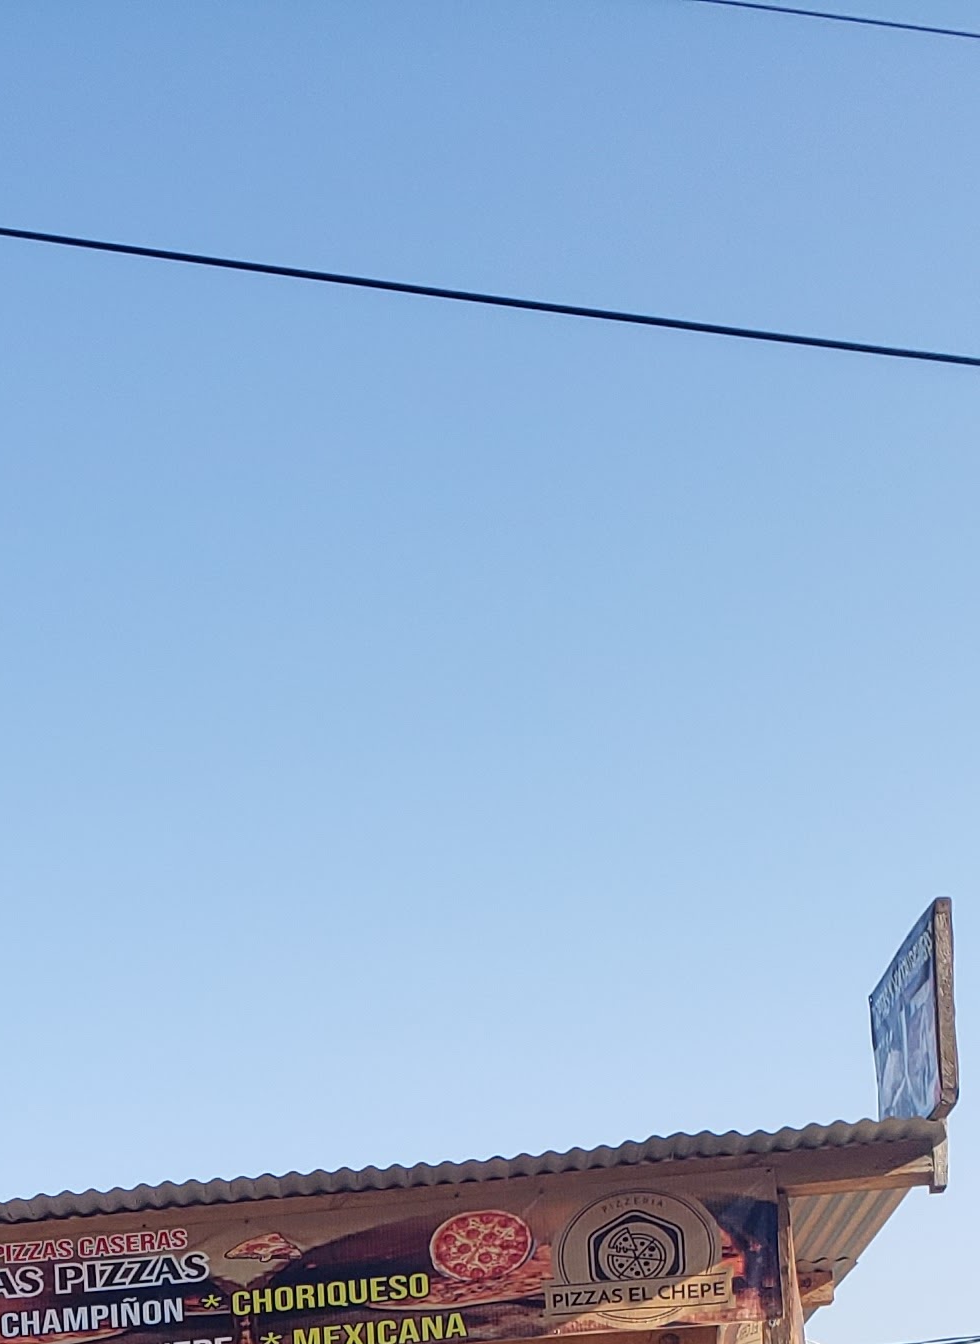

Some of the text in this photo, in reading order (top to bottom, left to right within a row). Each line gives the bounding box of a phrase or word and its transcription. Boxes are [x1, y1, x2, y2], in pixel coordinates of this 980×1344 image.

[77, 1228, 188, 1258] CASERAS
[54, 1251, 210, 1295] PIZZAS
[230, 1272, 430, 1317] CHORIQUESO
[553, 1281, 726, 1308] PIZZAS EL CHEPE
[0, 1297, 185, 1338] CHAMPIÑON
